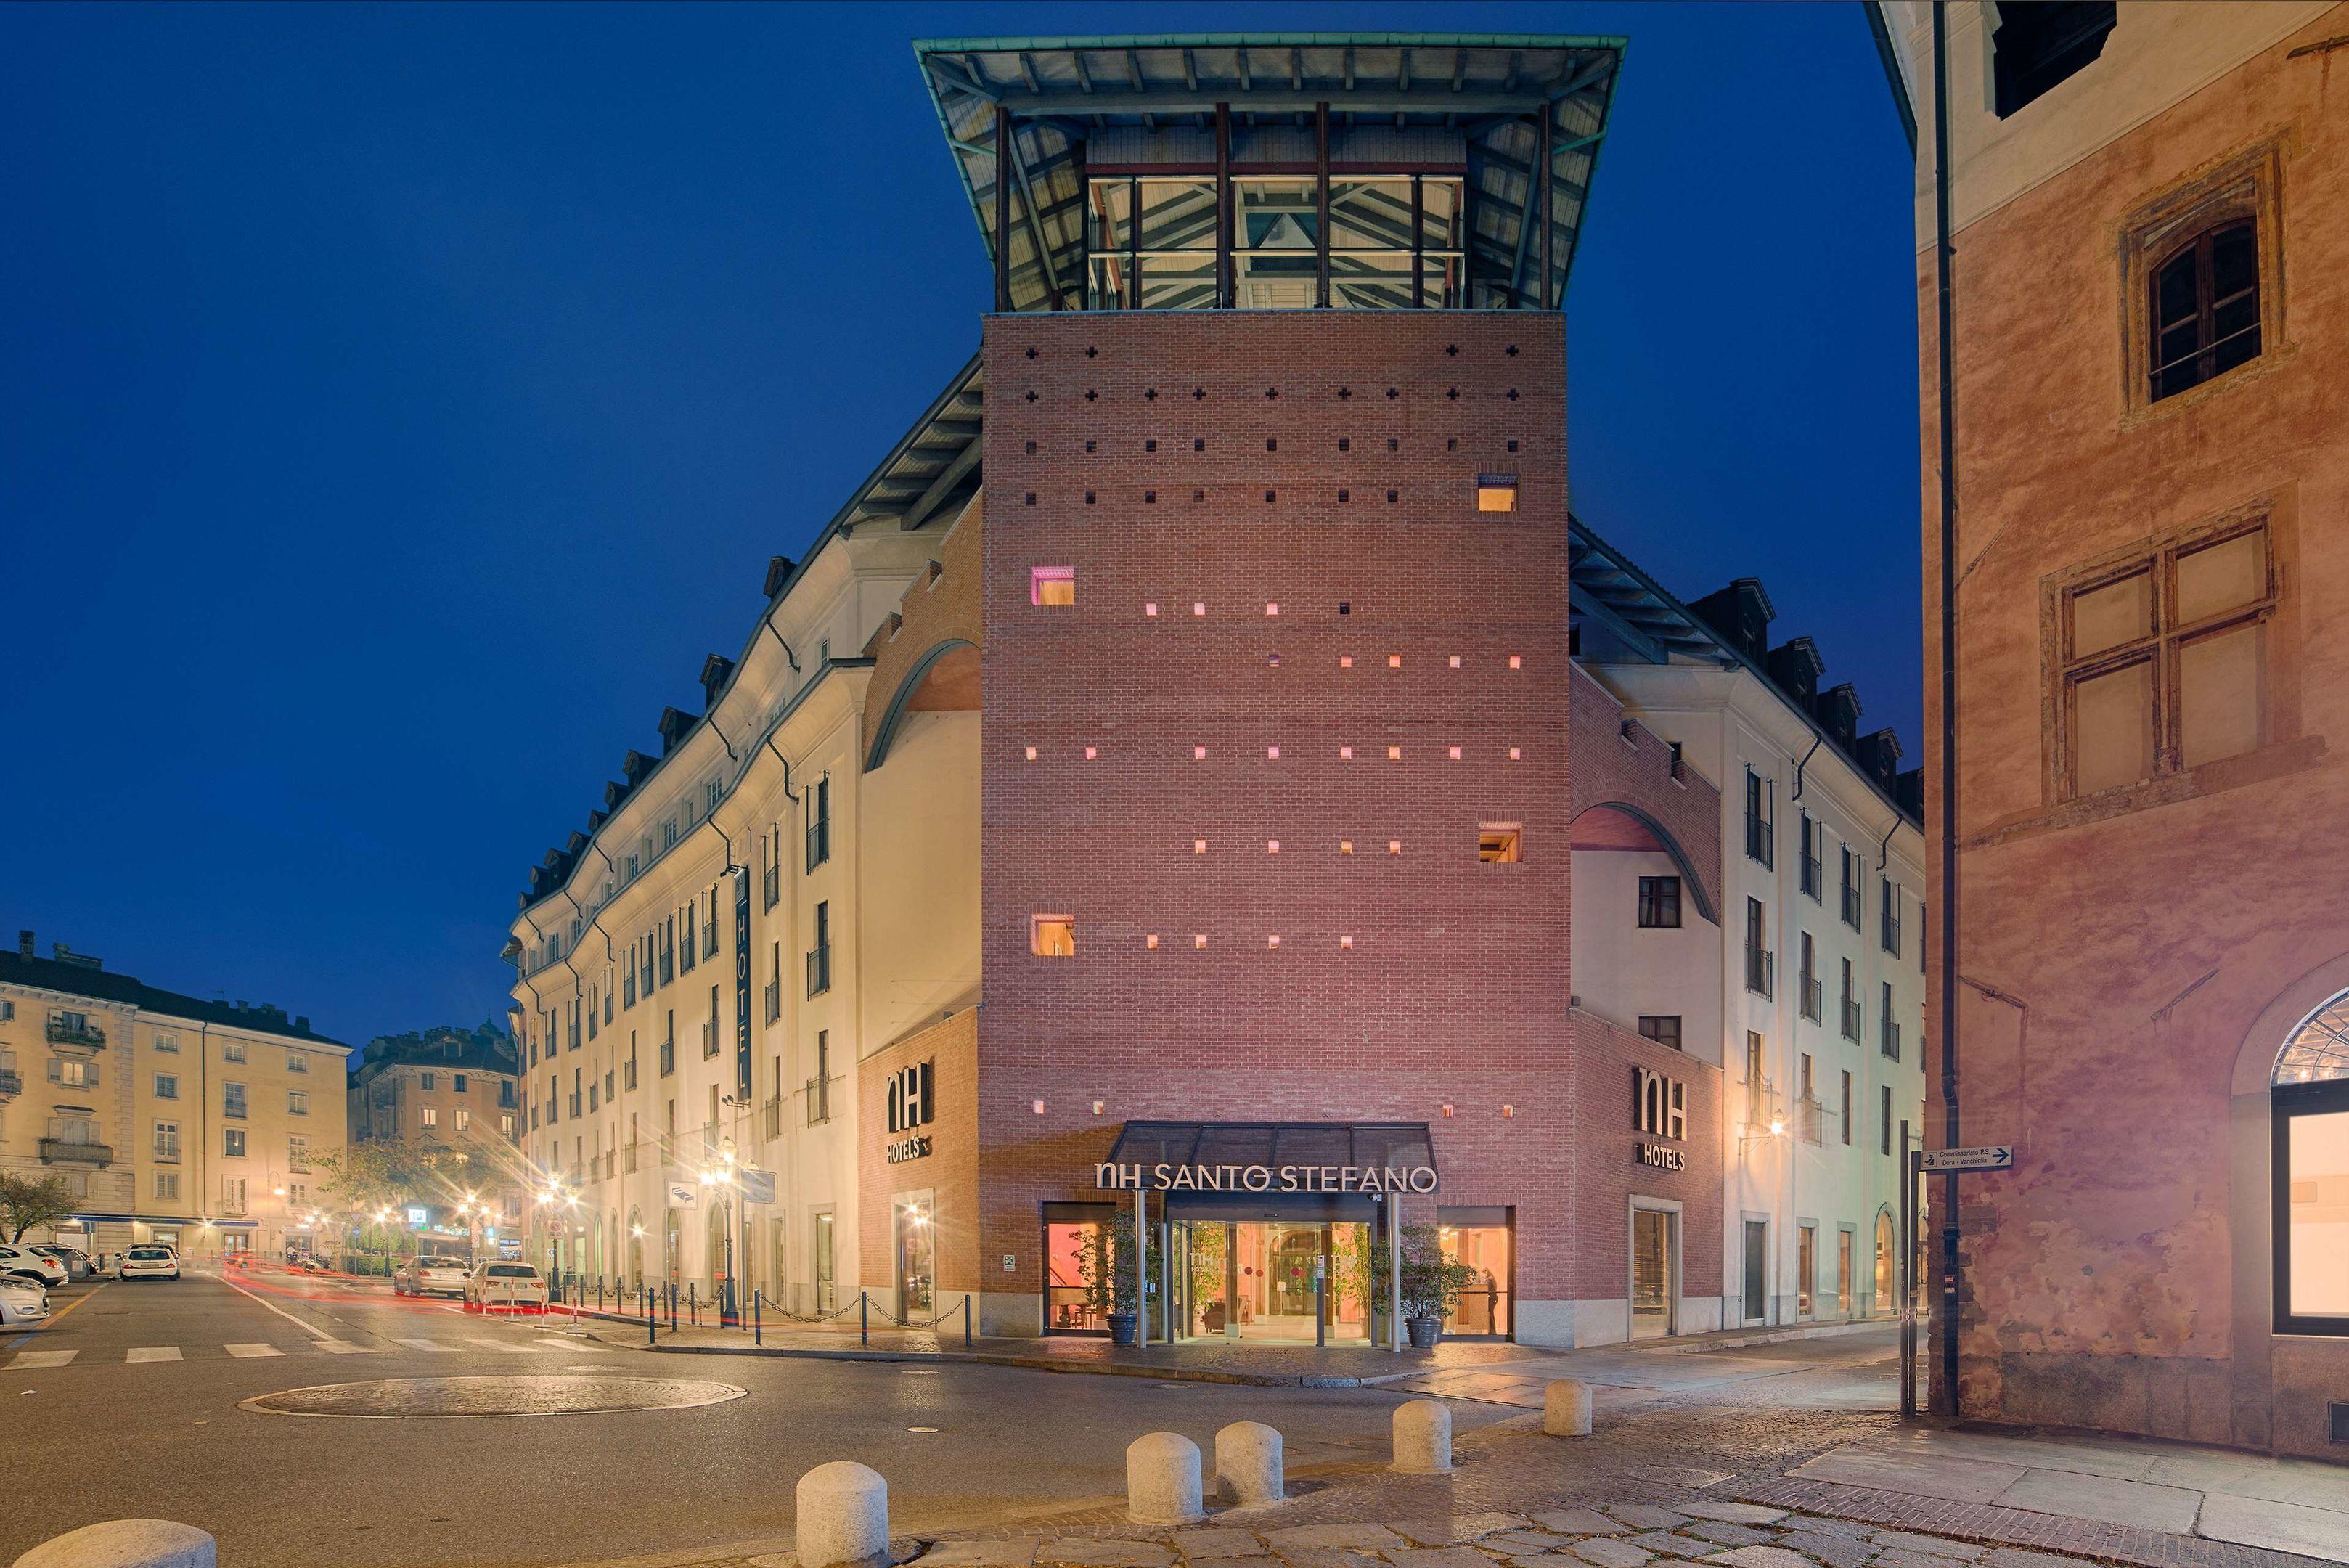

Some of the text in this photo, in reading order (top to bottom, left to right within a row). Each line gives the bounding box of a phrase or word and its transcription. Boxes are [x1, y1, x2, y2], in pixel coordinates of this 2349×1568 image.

[737, 915, 747, 1090] HOTEL
[887, 1136, 920, 1163] HOTELS
[1644, 1143, 1686, 1171] HOTELS
[1154, 1163, 1270, 1192] SANTO
[1280, 1165, 1438, 1193] STEFANO
